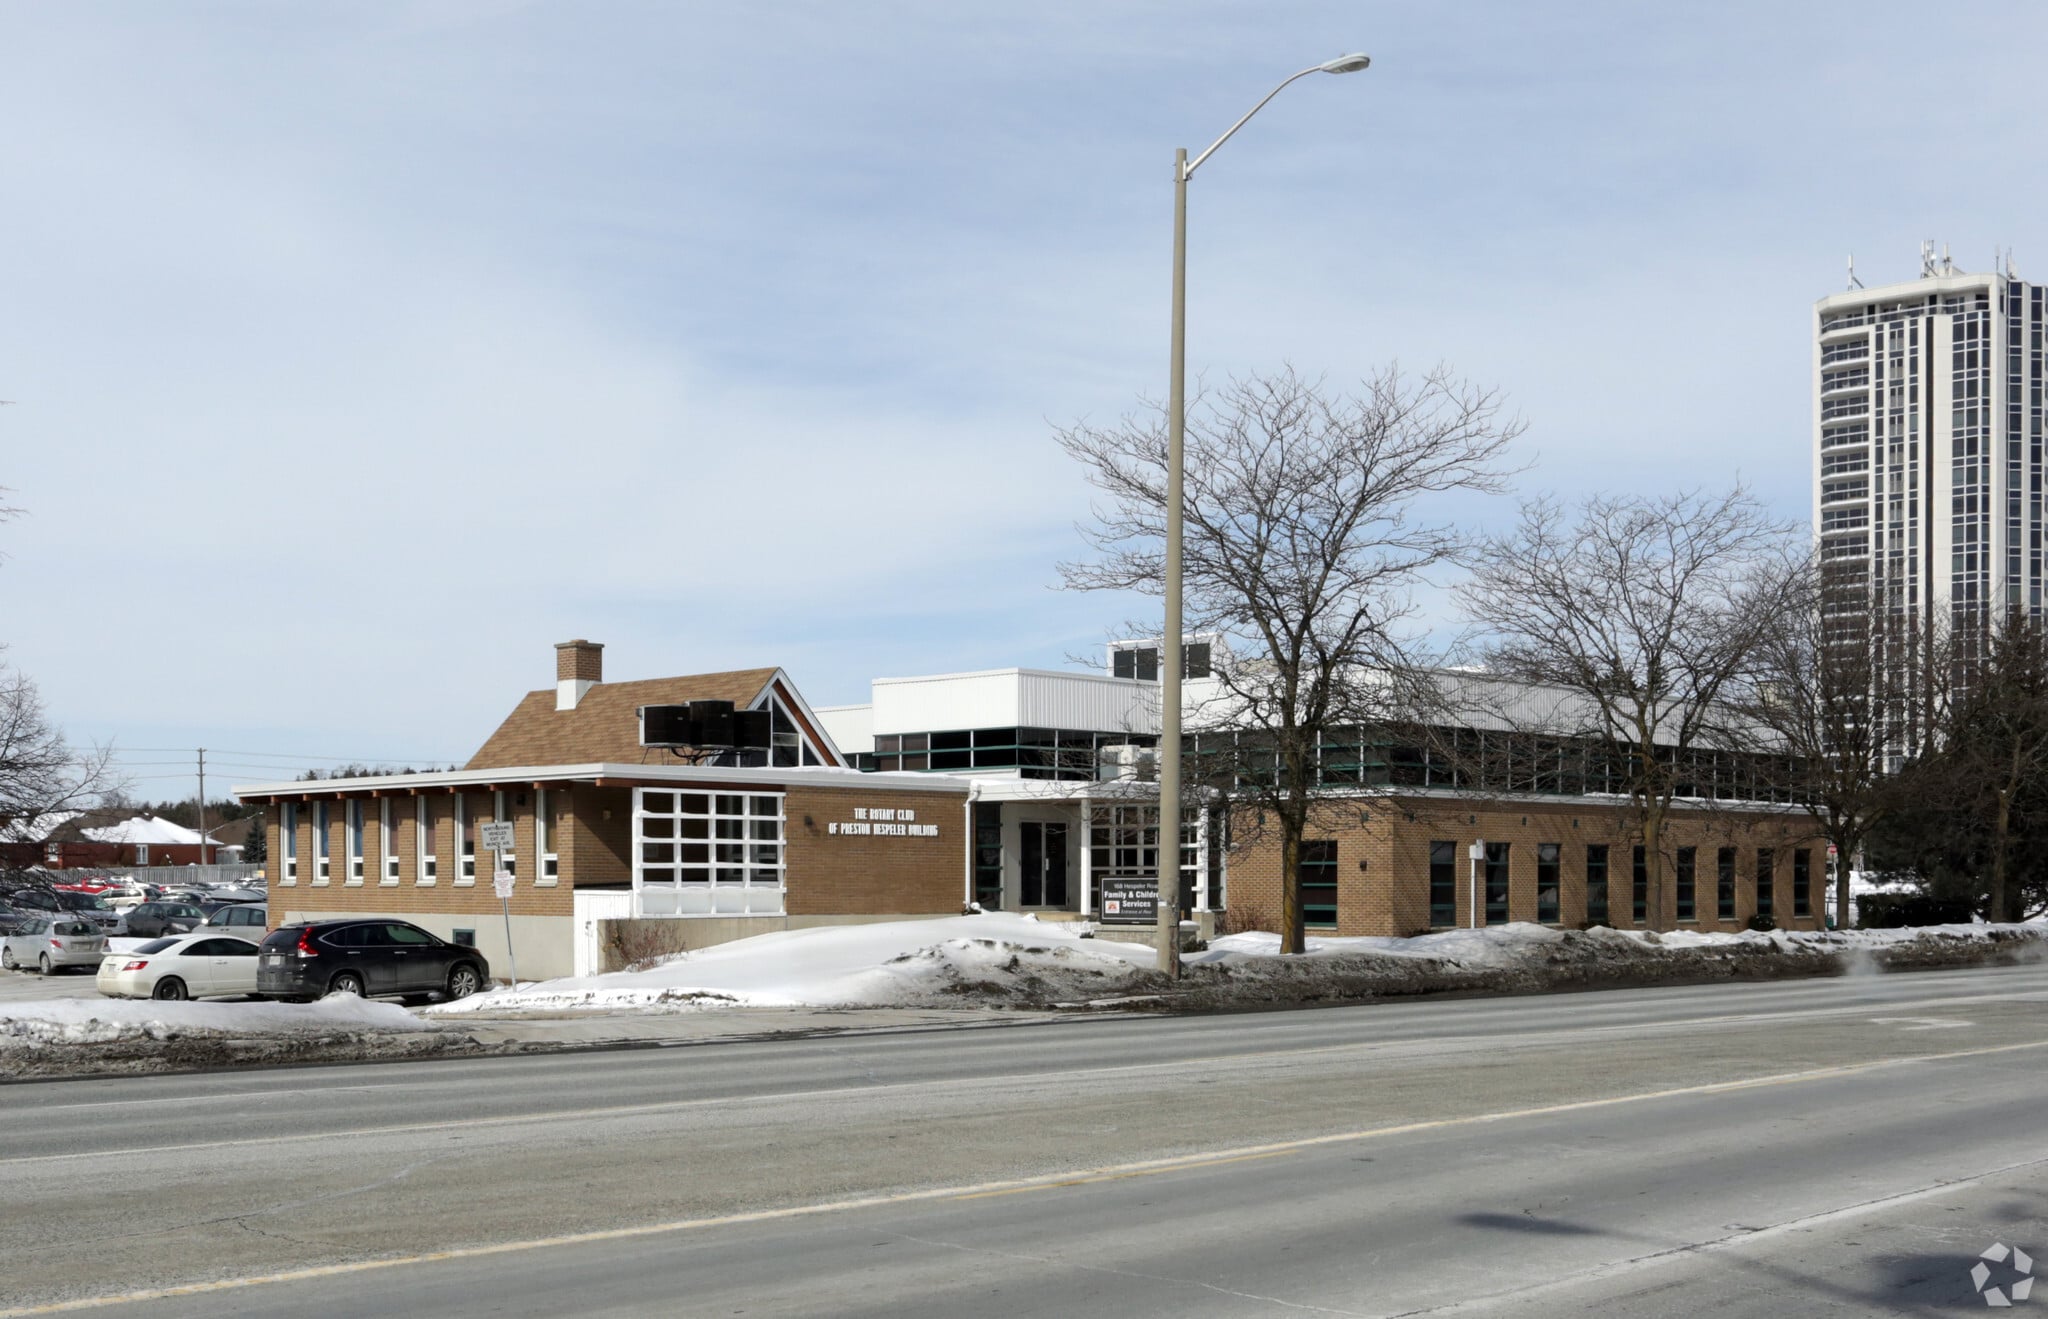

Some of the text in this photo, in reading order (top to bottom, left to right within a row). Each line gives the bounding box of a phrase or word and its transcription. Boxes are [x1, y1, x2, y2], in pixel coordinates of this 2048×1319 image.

[854, 808, 915, 822] THE ROTARY CLUB
[828, 822, 938, 836] OF PRESTON HESPELER BUILDING
[1104, 890, 1126, 900] Family
[1128, 890, 1134, 898] &
